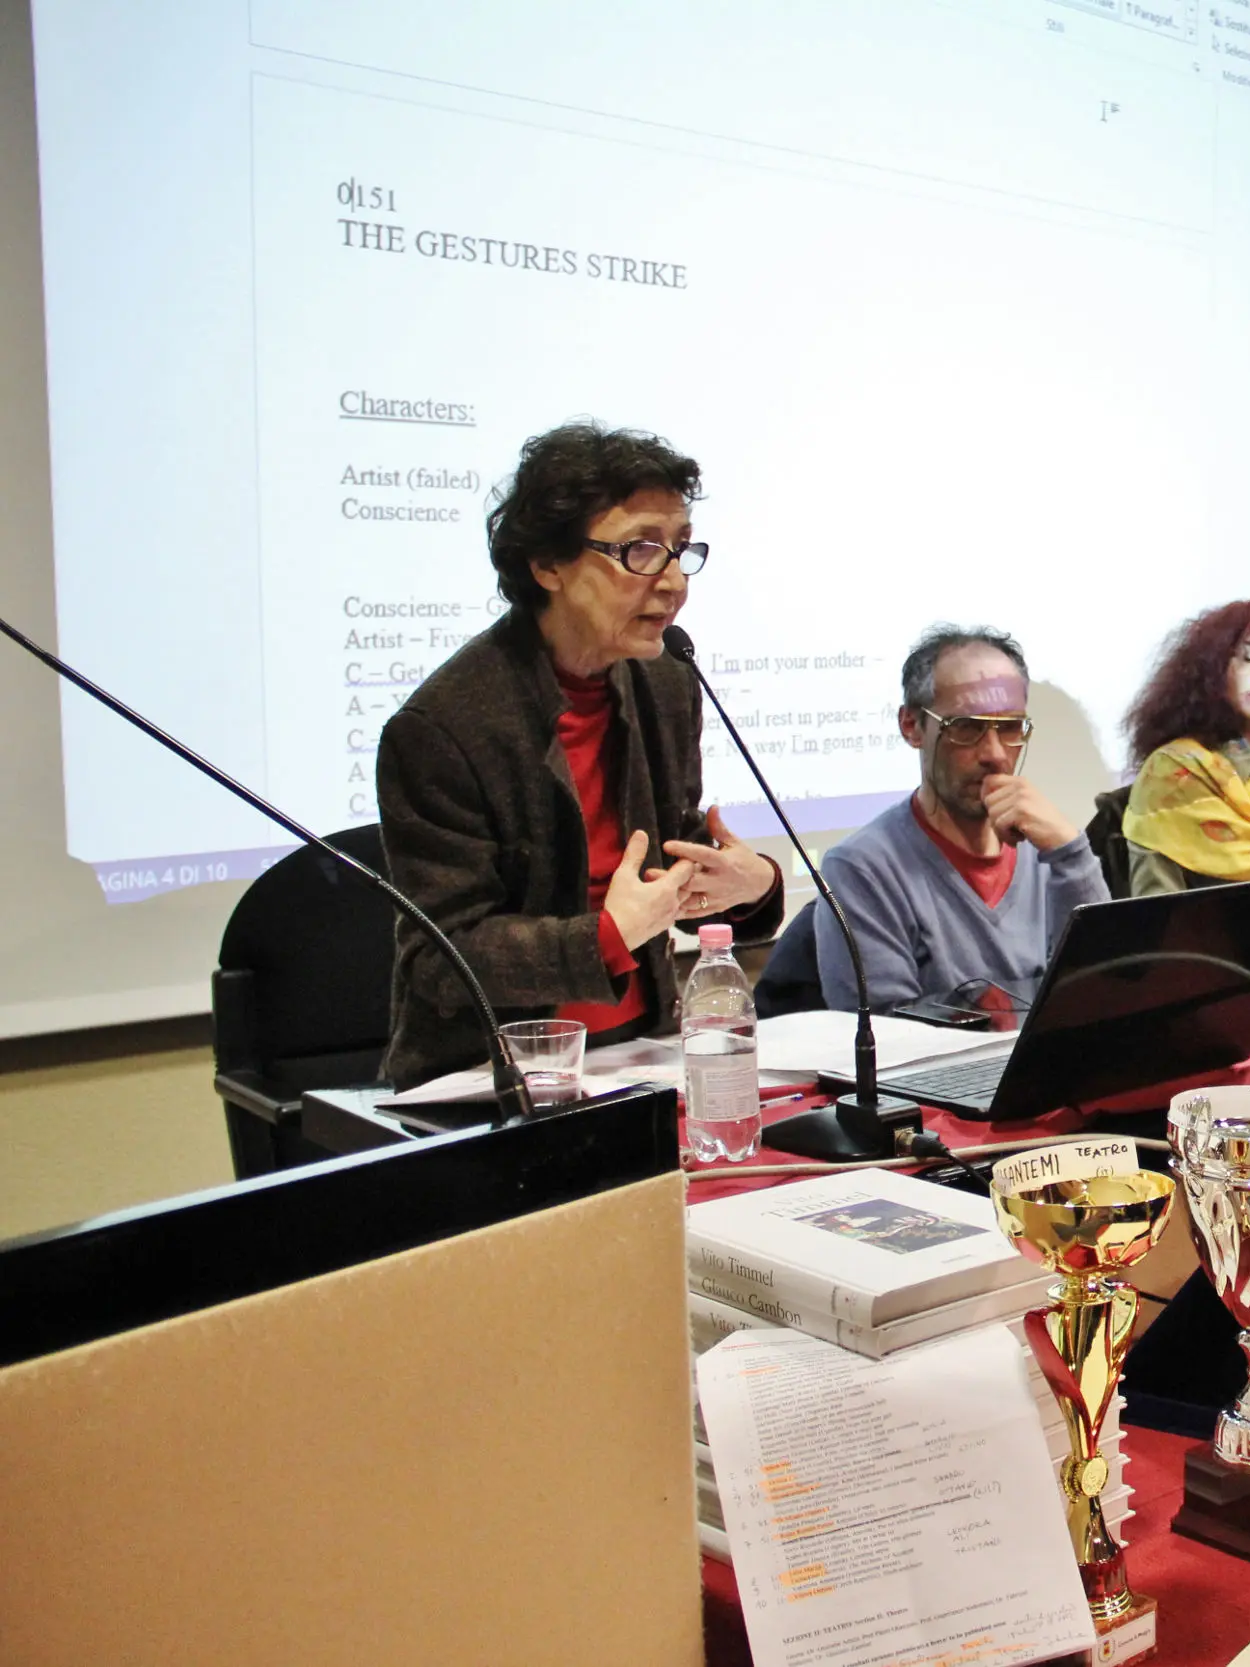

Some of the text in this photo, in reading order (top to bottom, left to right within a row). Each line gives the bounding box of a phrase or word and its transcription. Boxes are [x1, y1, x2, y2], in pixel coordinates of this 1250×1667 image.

[337, 218, 688, 290] THE GESTURES STRIKE
[339, 389, 476, 424] Characters:
[340, 464, 480, 494] Artist (failed)
[341, 496, 460, 522] Conscience
[343, 595, 461, 619] Conscience
[344, 629, 403, 651] Artist
[389, 661, 424, 684] Get
[711, 653, 741, 673] I'm
[744, 656, 770, 671] not
[774, 656, 809, 675] your
[814, 650, 866, 669] mother
[765, 711, 793, 727] rest
[798, 711, 813, 725] in
[755, 740, 786, 758] way
[822, 735, 864, 756] going
[868, 733, 882, 747] to
[162, 866, 174, 884] 4
[180, 865, 200, 885] DI
[206, 862, 228, 882] 10
[1074, 1143, 1129, 1159] TEATRO
[701, 1247, 775, 1288] Vito Timmel
[701, 1276, 745, 1305] Glauco
[748, 1294, 802, 1326] Cambon
